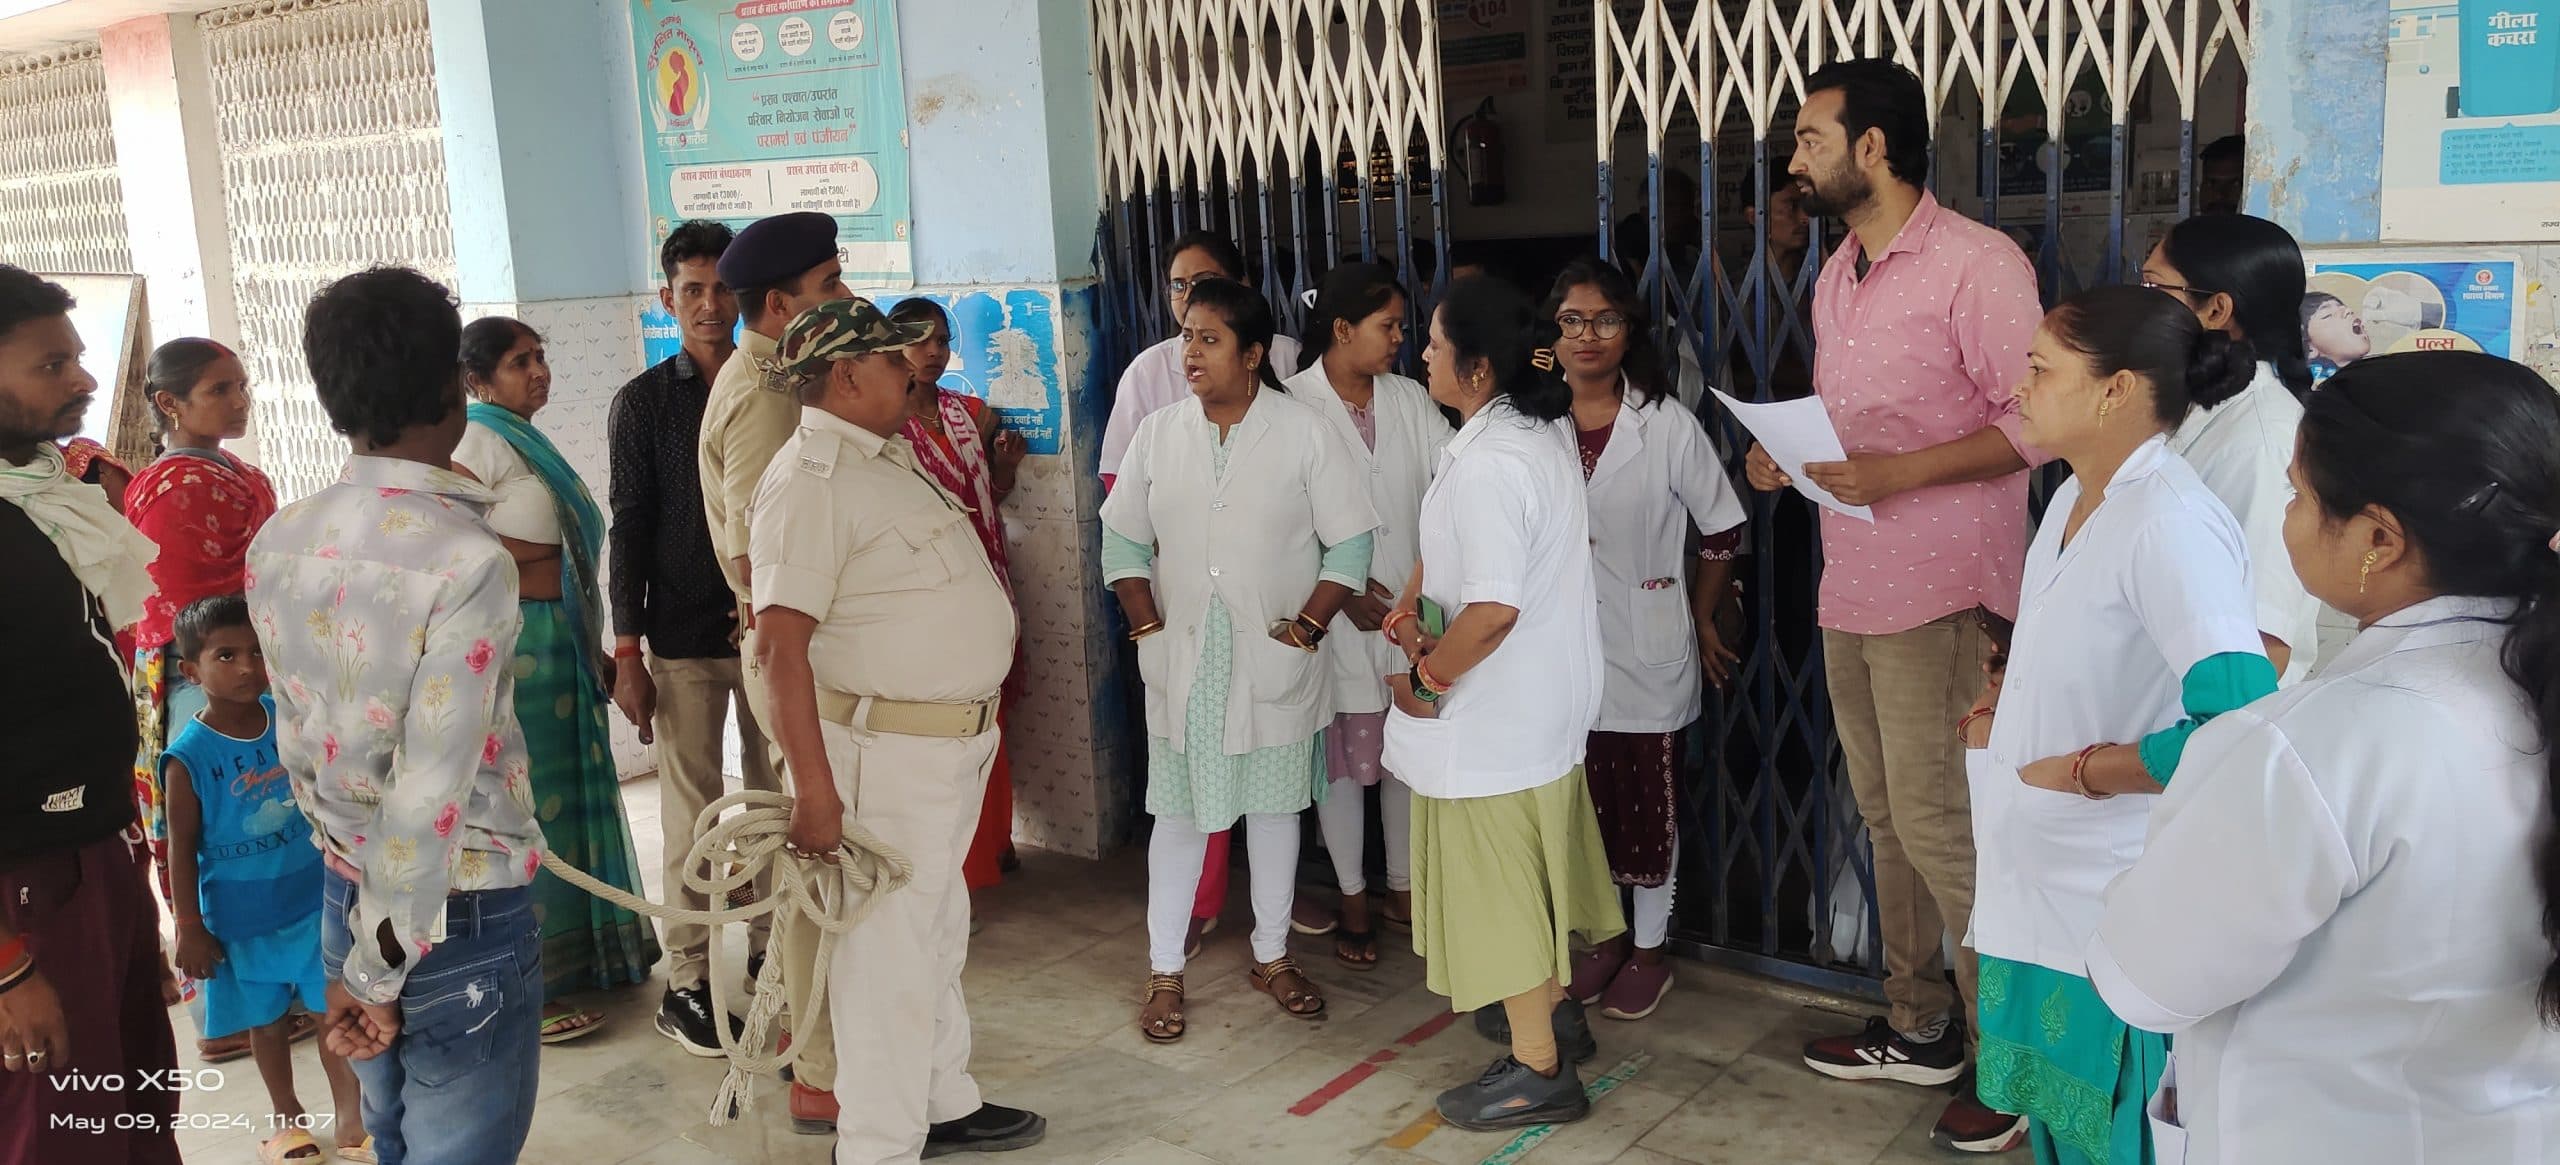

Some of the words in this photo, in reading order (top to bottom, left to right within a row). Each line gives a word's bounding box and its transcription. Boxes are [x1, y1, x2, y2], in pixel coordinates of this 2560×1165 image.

[1481, 0, 1507, 17] 104
[2487, 11, 2538, 29] गीला
[2487, 29, 2537, 47] कचरा
[844, 107, 855, 120] पर
[2415, 337, 2456, 351] पल्स
